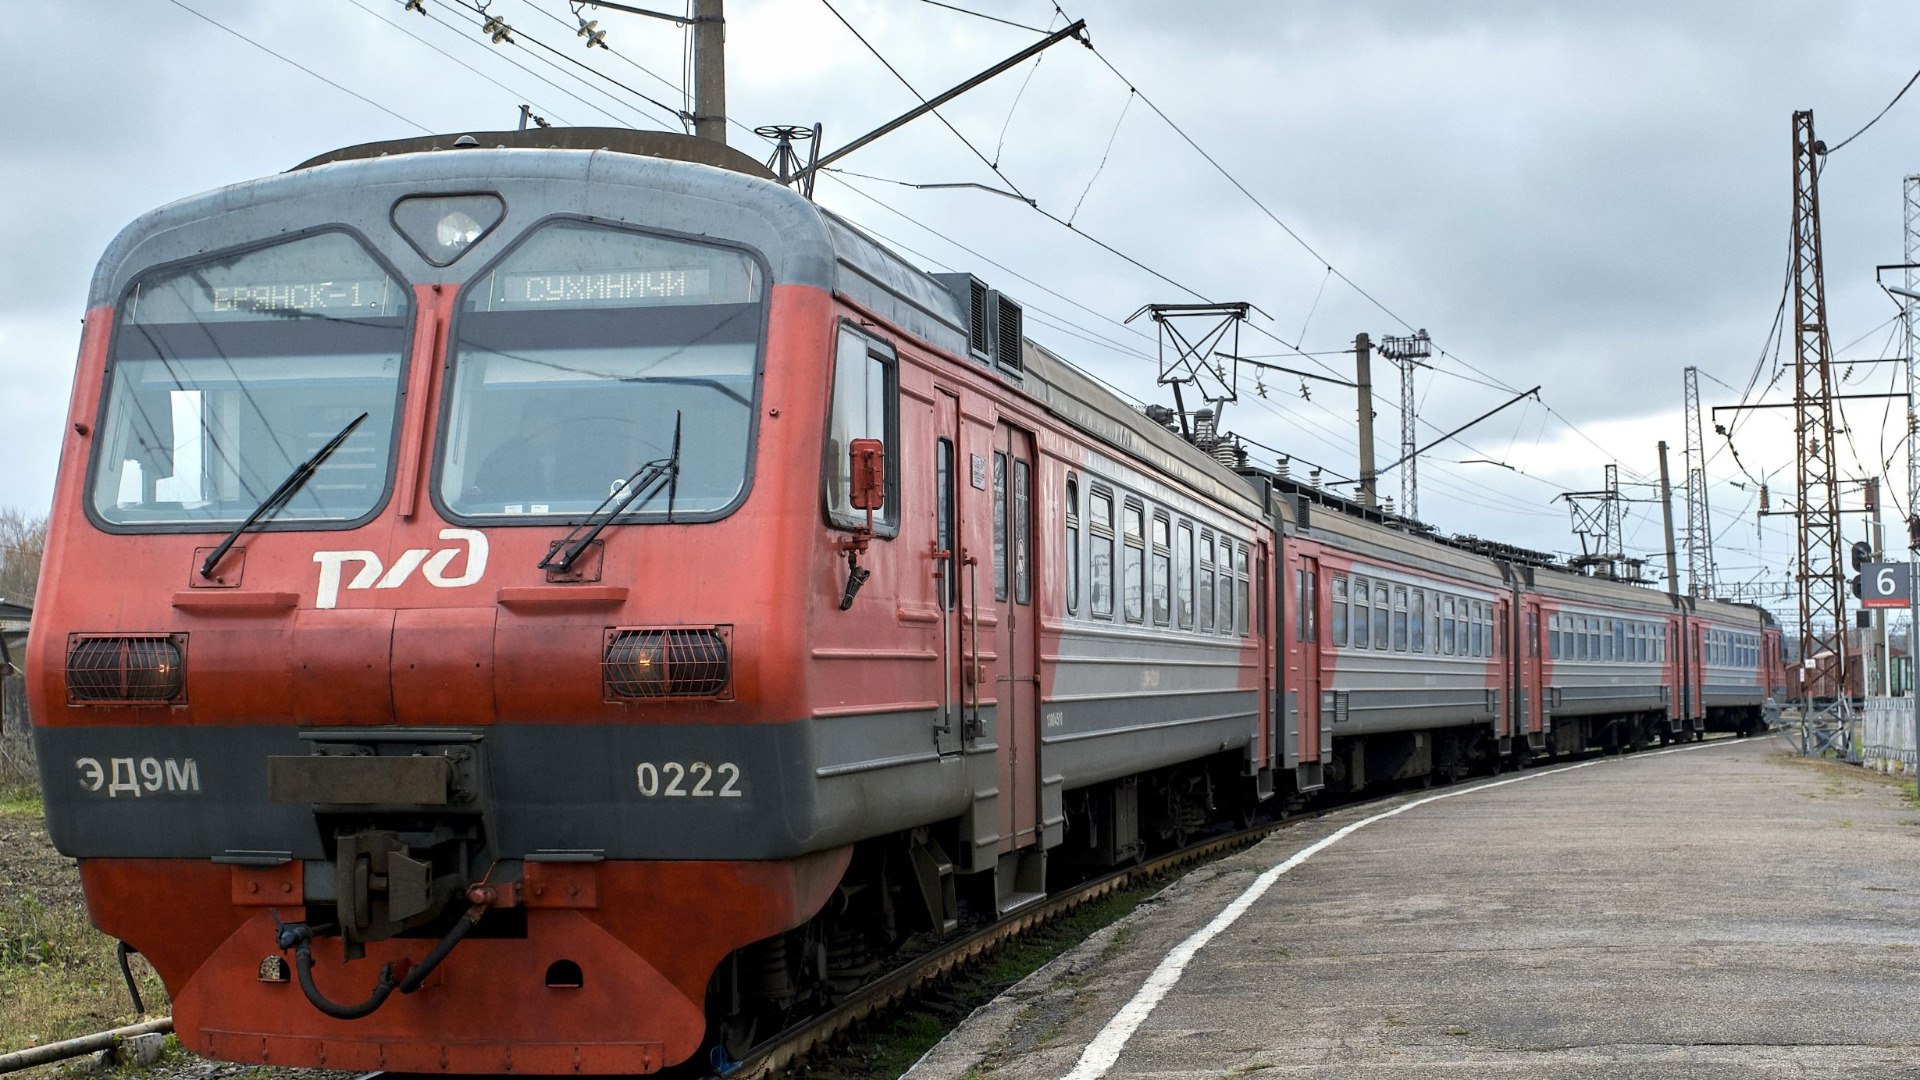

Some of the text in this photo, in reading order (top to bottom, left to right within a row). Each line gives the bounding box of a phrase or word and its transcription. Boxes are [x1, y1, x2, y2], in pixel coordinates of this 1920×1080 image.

[213, 282, 362, 311] БРЯНСК-1
[526, 272, 685, 302] СУХИНИЧИ
[1876, 567, 1896, 596] 6
[75, 756, 200, 798] ЭД9М
[637, 762, 742, 797] 0222
